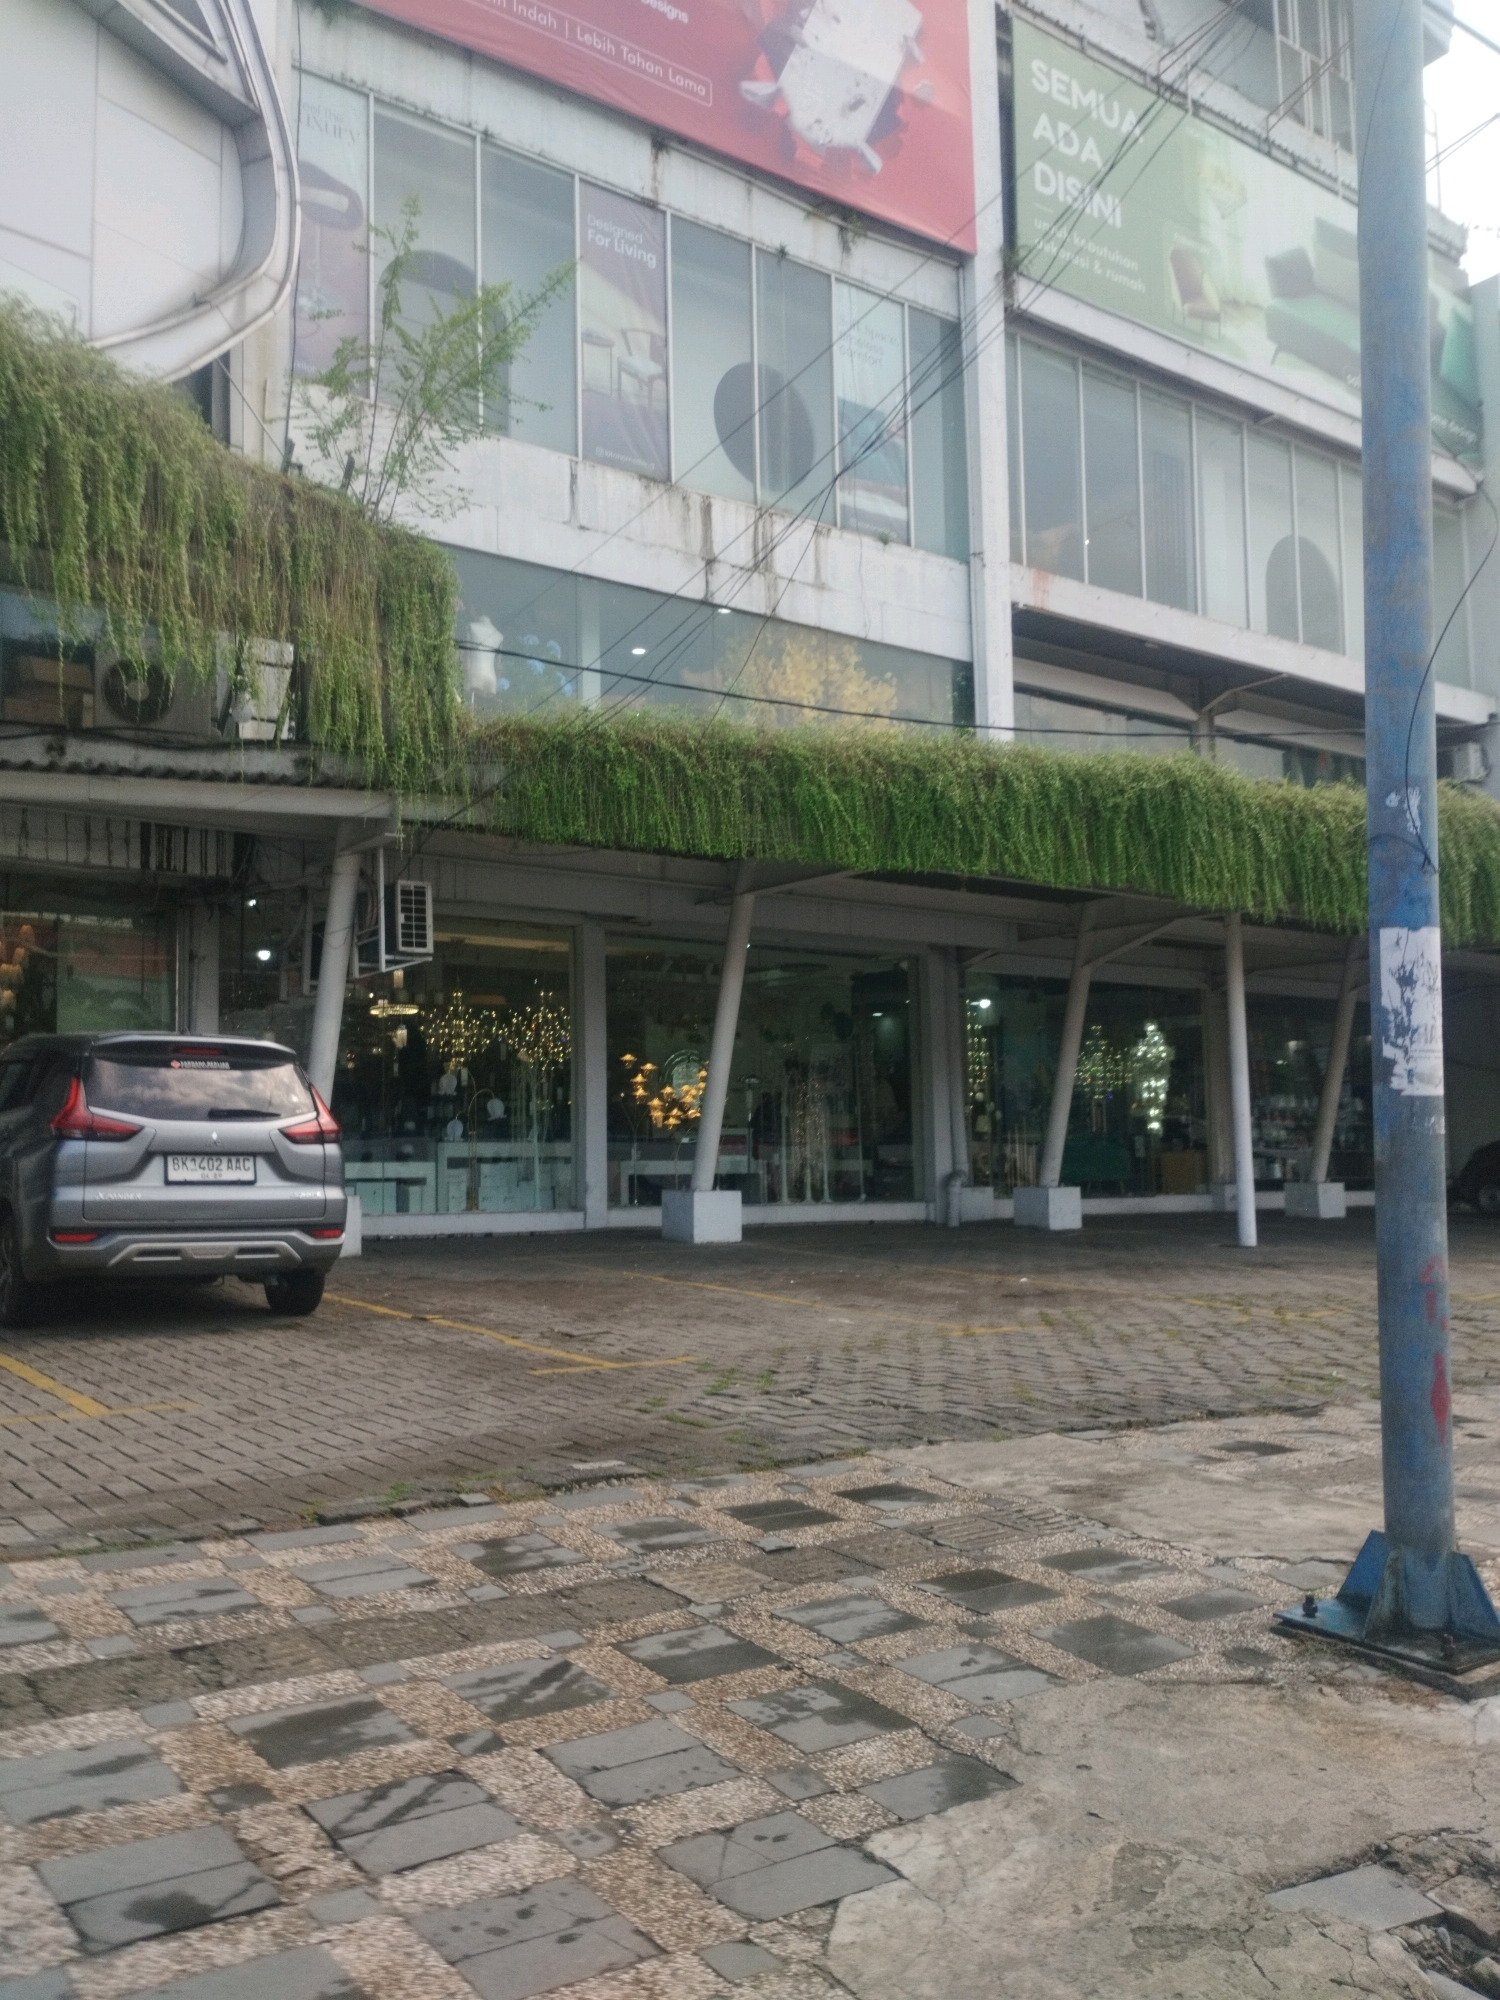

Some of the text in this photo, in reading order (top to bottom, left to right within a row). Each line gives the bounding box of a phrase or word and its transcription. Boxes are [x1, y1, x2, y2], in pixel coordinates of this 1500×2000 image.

[641, 0, 688, 23] esigns
[513, 0, 706, 97] Indah Lebih Tahan Lama
[1031, 58, 1144, 143] SEMUA
[1032, 112, 1103, 171] ADA
[587, 213, 643, 245] Designed
[588, 228, 657, 269] For Living
[1105, 268, 1146, 293] rumah
[172, 1156, 189, 1171] BK
[226, 1156, 250, 1172] AAC
